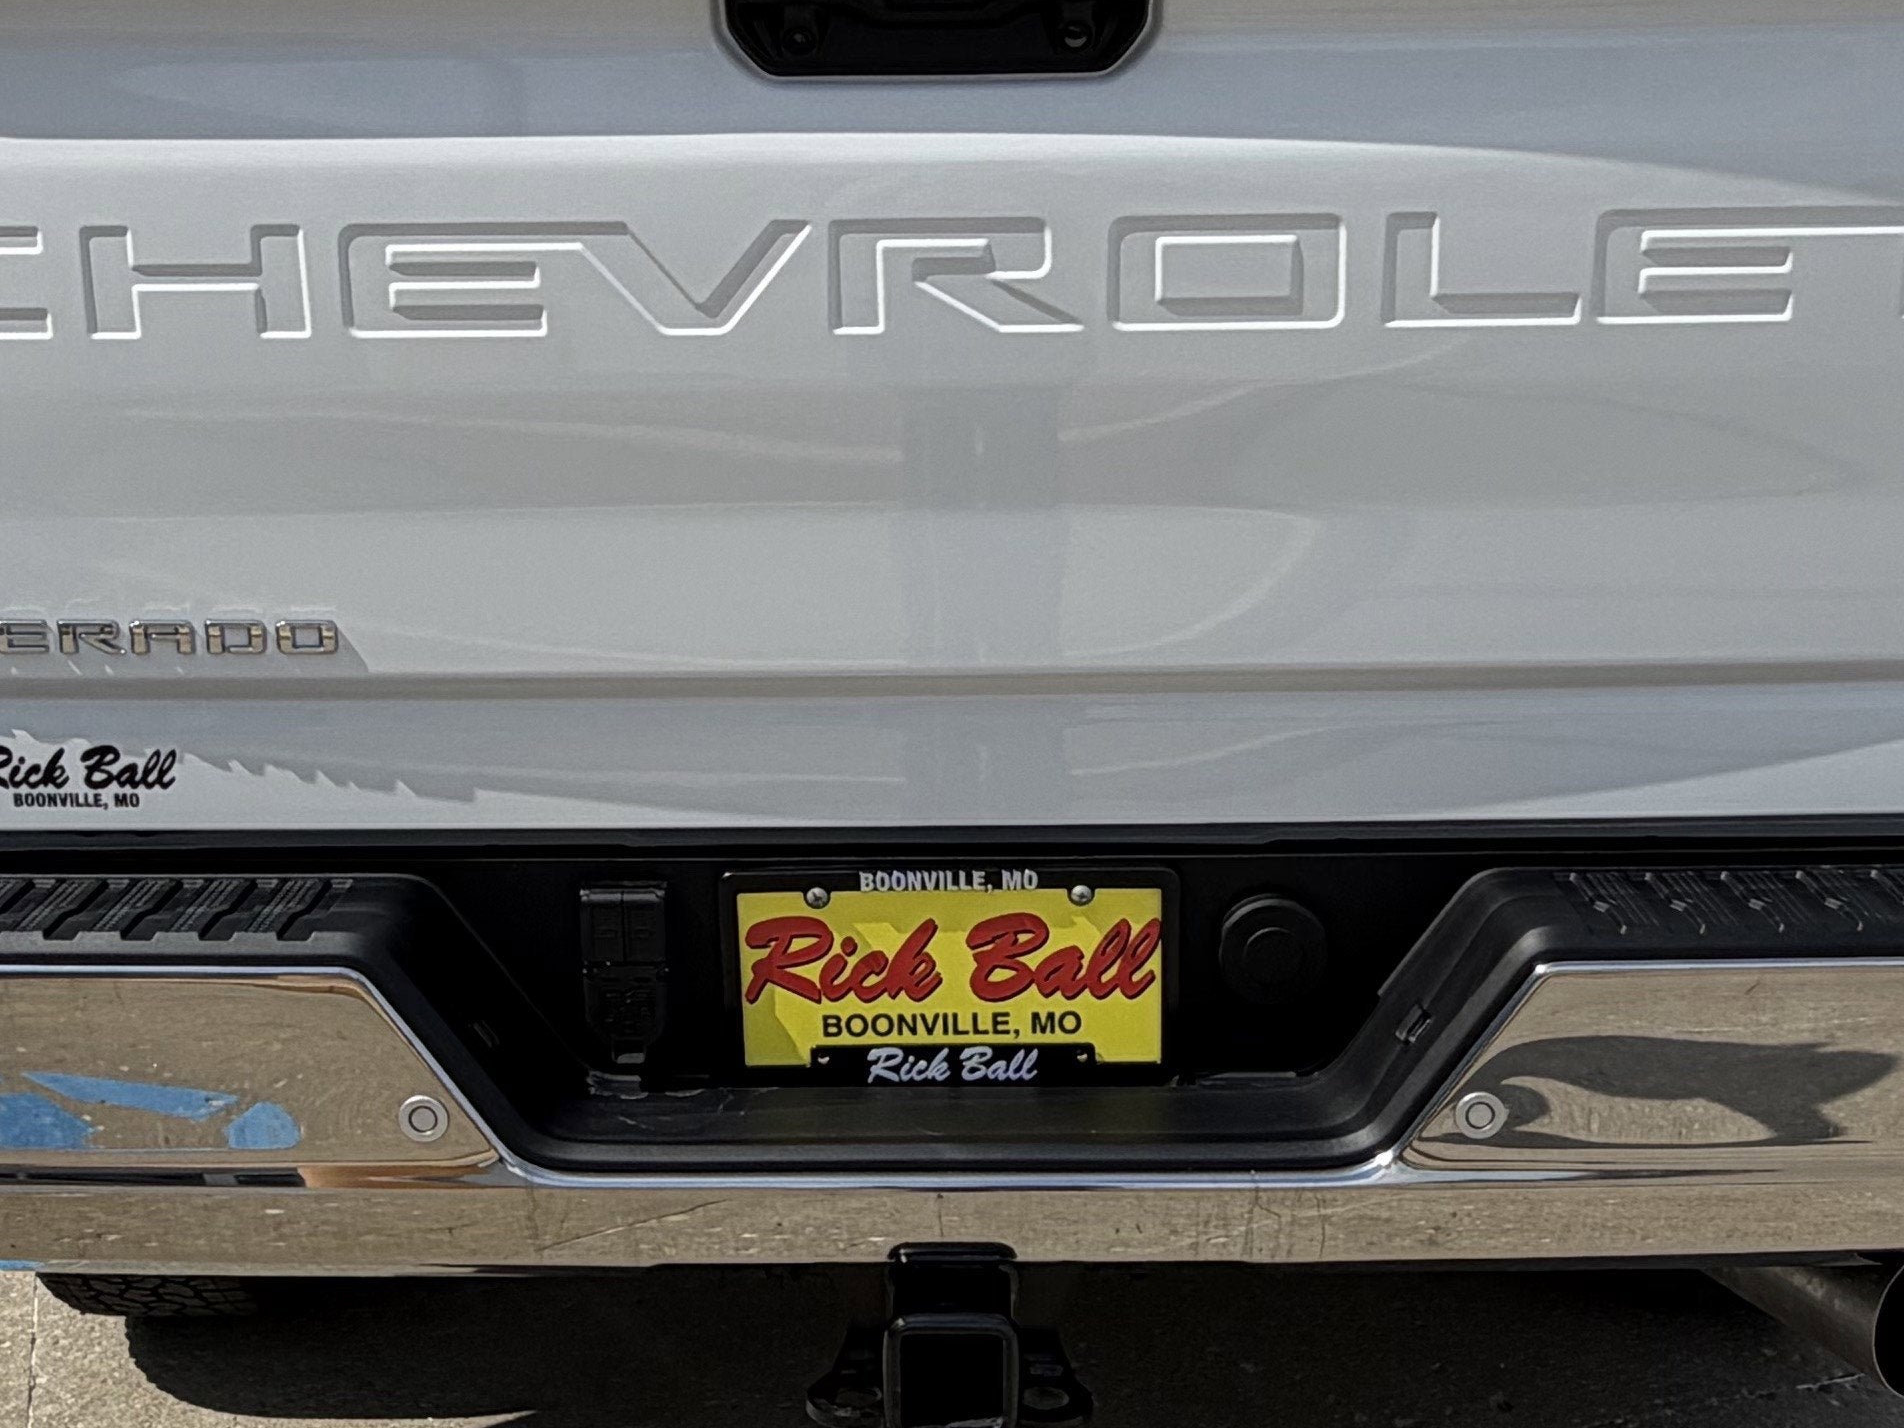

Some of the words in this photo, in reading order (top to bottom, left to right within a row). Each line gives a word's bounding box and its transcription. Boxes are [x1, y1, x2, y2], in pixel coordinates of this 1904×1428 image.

[80, 744, 177, 790] Ball
[13, 792, 109, 810] BOONVILLE,
[114, 792, 140, 808] MO
[859, 870, 995, 894] BOONVILLE,
[1001, 870, 1039, 891] MO
[744, 915, 943, 1004] Rick
[966, 912, 1162, 1003] Ball
[822, 1012, 1021, 1039] BOONVILLE,
[1031, 1011, 1082, 1035] MO
[866, 1047, 953, 1084] Rick
[959, 1046, 1039, 1082] Ball
